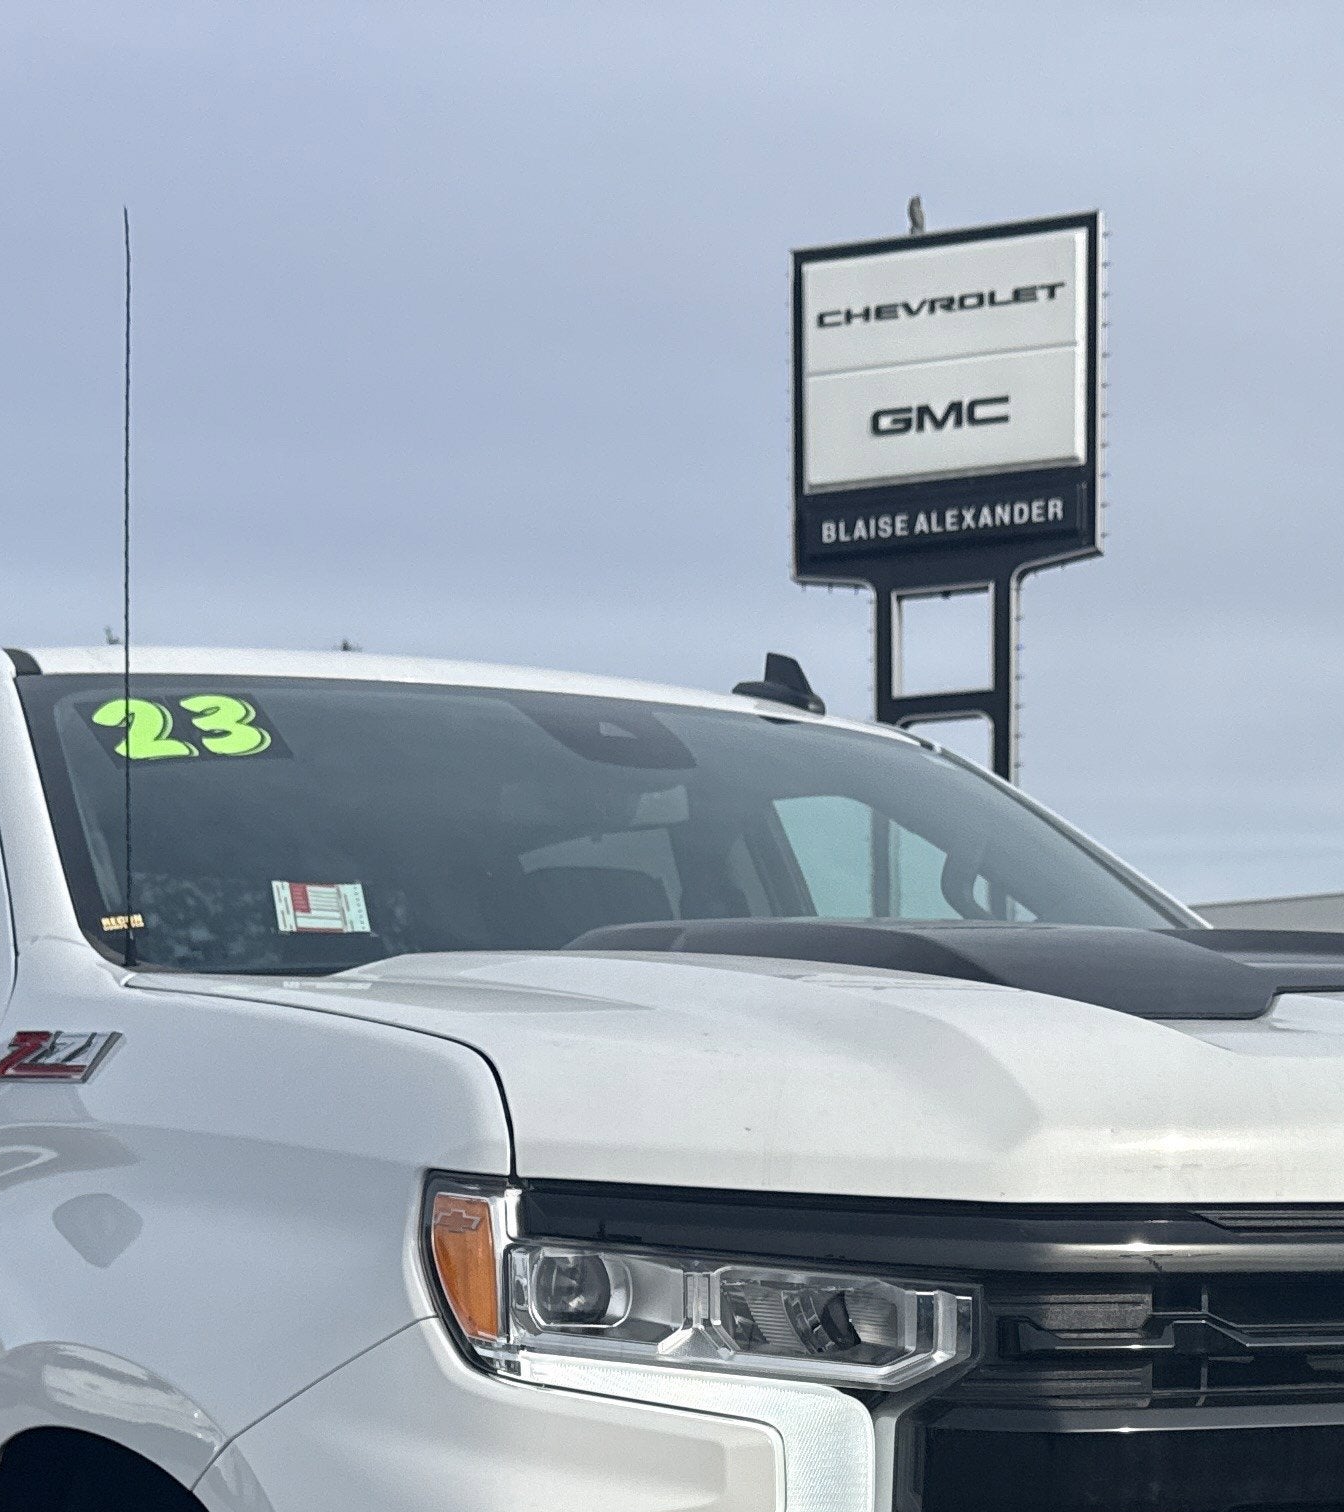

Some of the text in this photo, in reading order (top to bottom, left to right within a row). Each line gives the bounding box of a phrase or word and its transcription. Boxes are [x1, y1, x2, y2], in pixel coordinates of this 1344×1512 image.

[816, 282, 1066, 329] CHEVROLET
[869, 395, 1010, 438] GMC
[821, 498, 1064, 544] BLAISE ALEXANDER
[91, 694, 272, 760] 23
